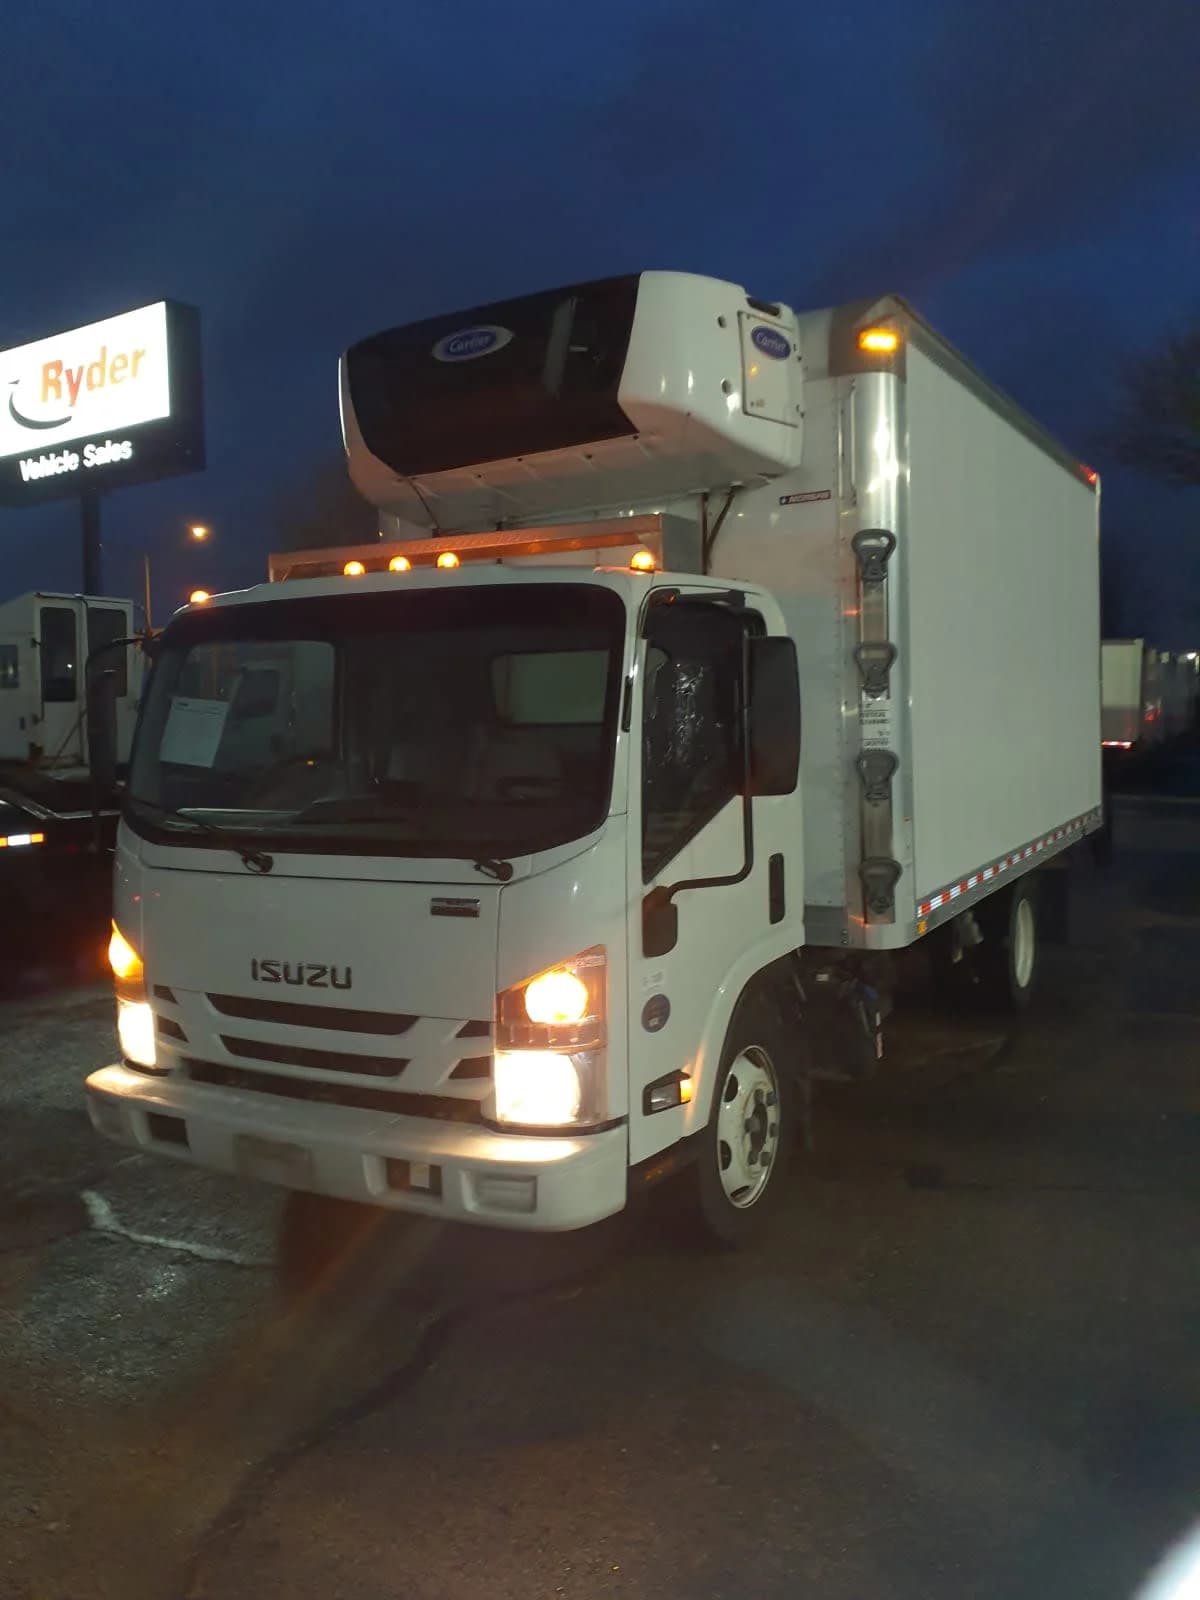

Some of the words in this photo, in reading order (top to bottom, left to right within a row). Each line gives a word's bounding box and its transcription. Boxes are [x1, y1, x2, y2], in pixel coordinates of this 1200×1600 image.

[41, 345, 146, 407] Ryder
[19, 449, 80, 482] Vehicle
[82, 440, 133, 467] Sales
[251, 958, 352, 989] ISUZU
